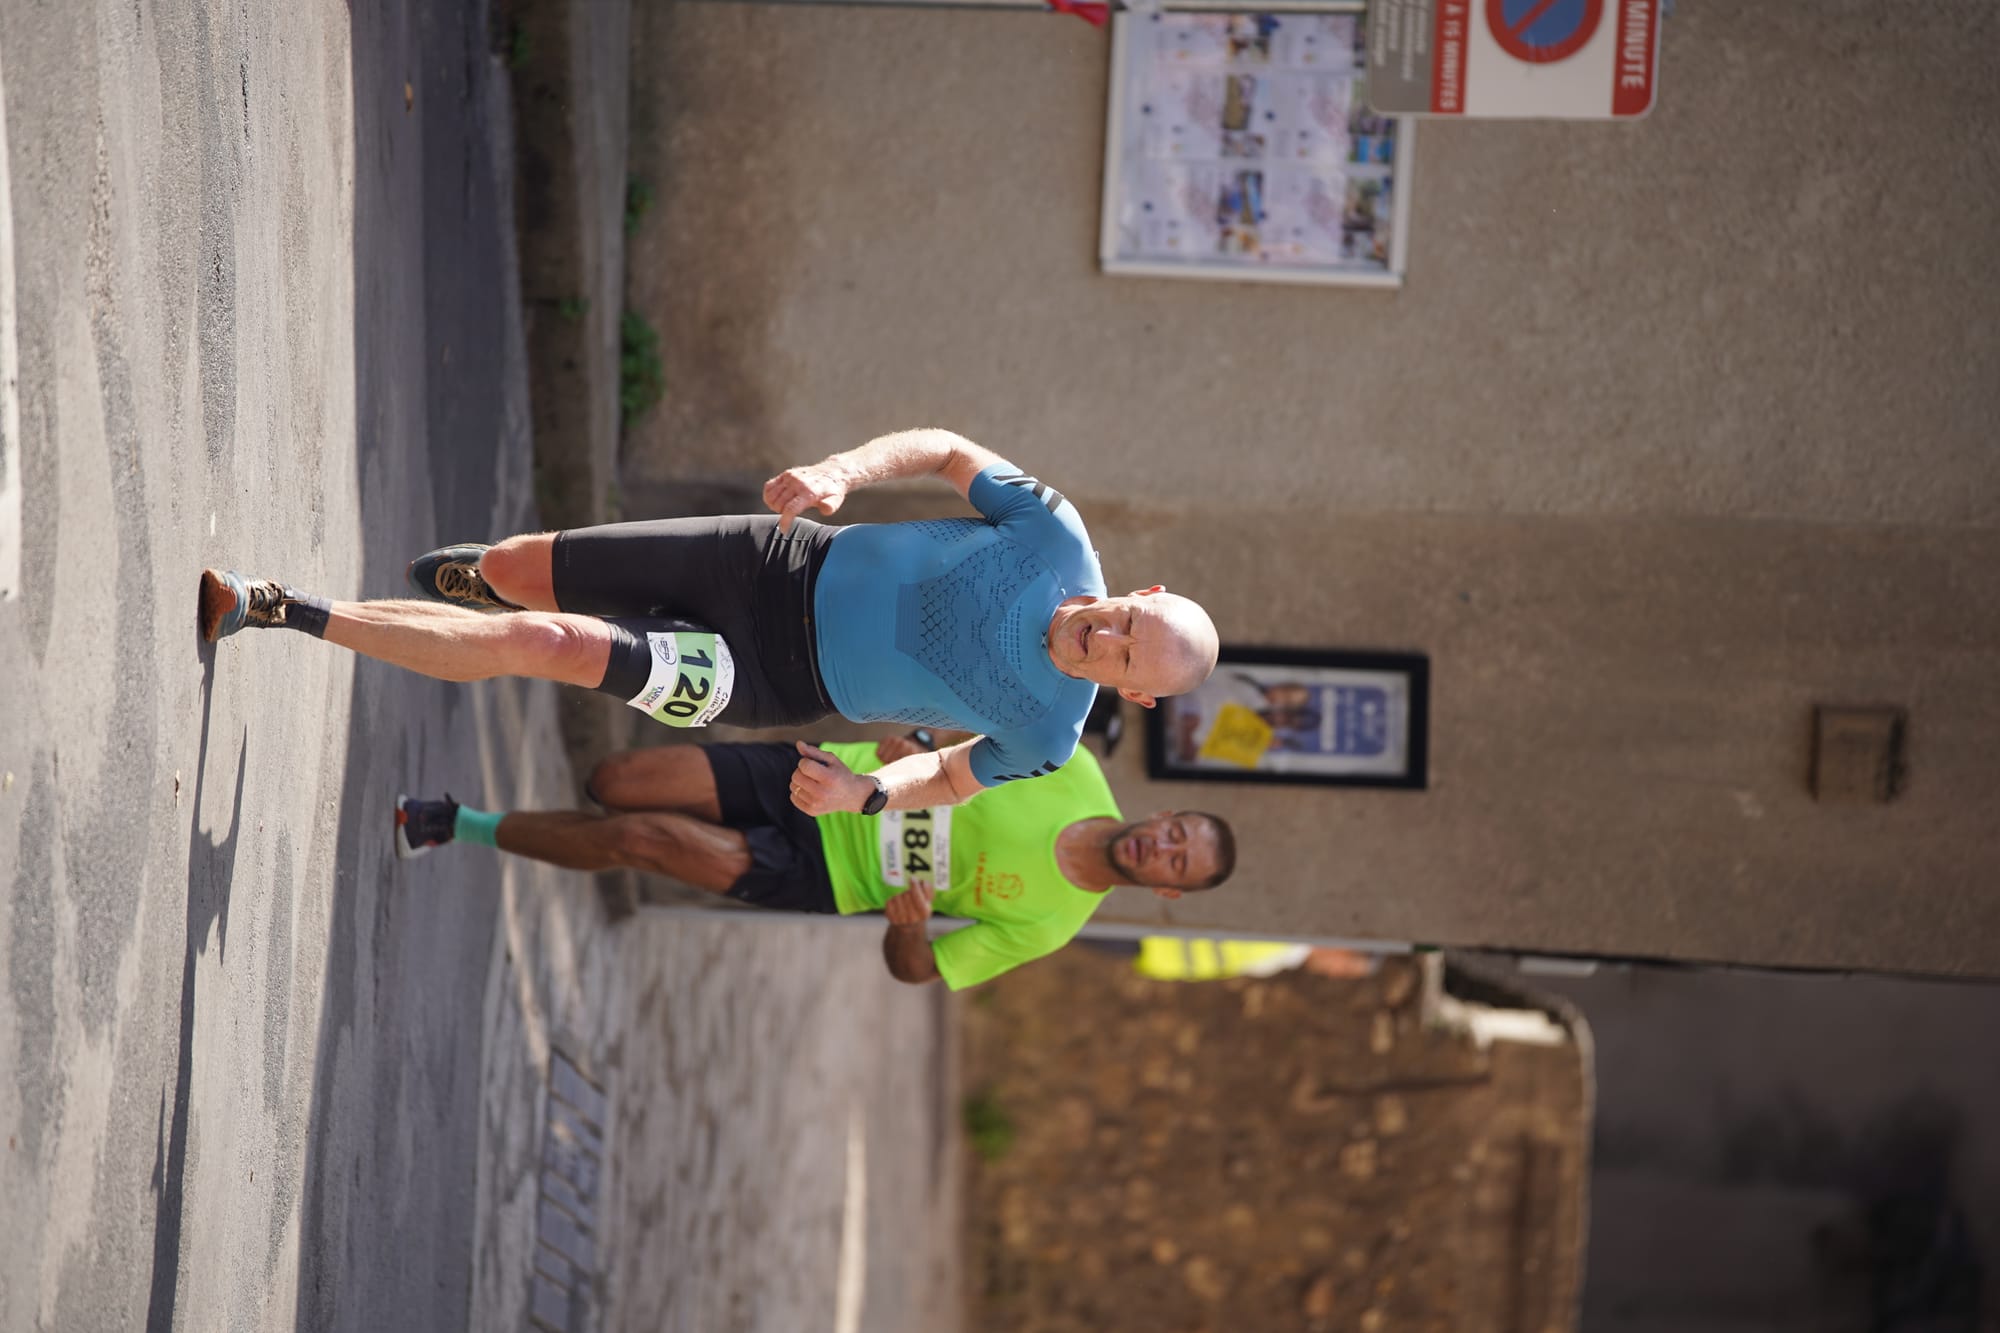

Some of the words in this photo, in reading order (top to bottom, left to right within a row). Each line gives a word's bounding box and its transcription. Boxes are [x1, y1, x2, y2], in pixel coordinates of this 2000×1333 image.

[1438, 40, 1459, 109] MINUTES
[1622, 1, 1649, 88] MINUTE
[663, 649, 713, 717] 120
[904, 809, 931, 874] 184
